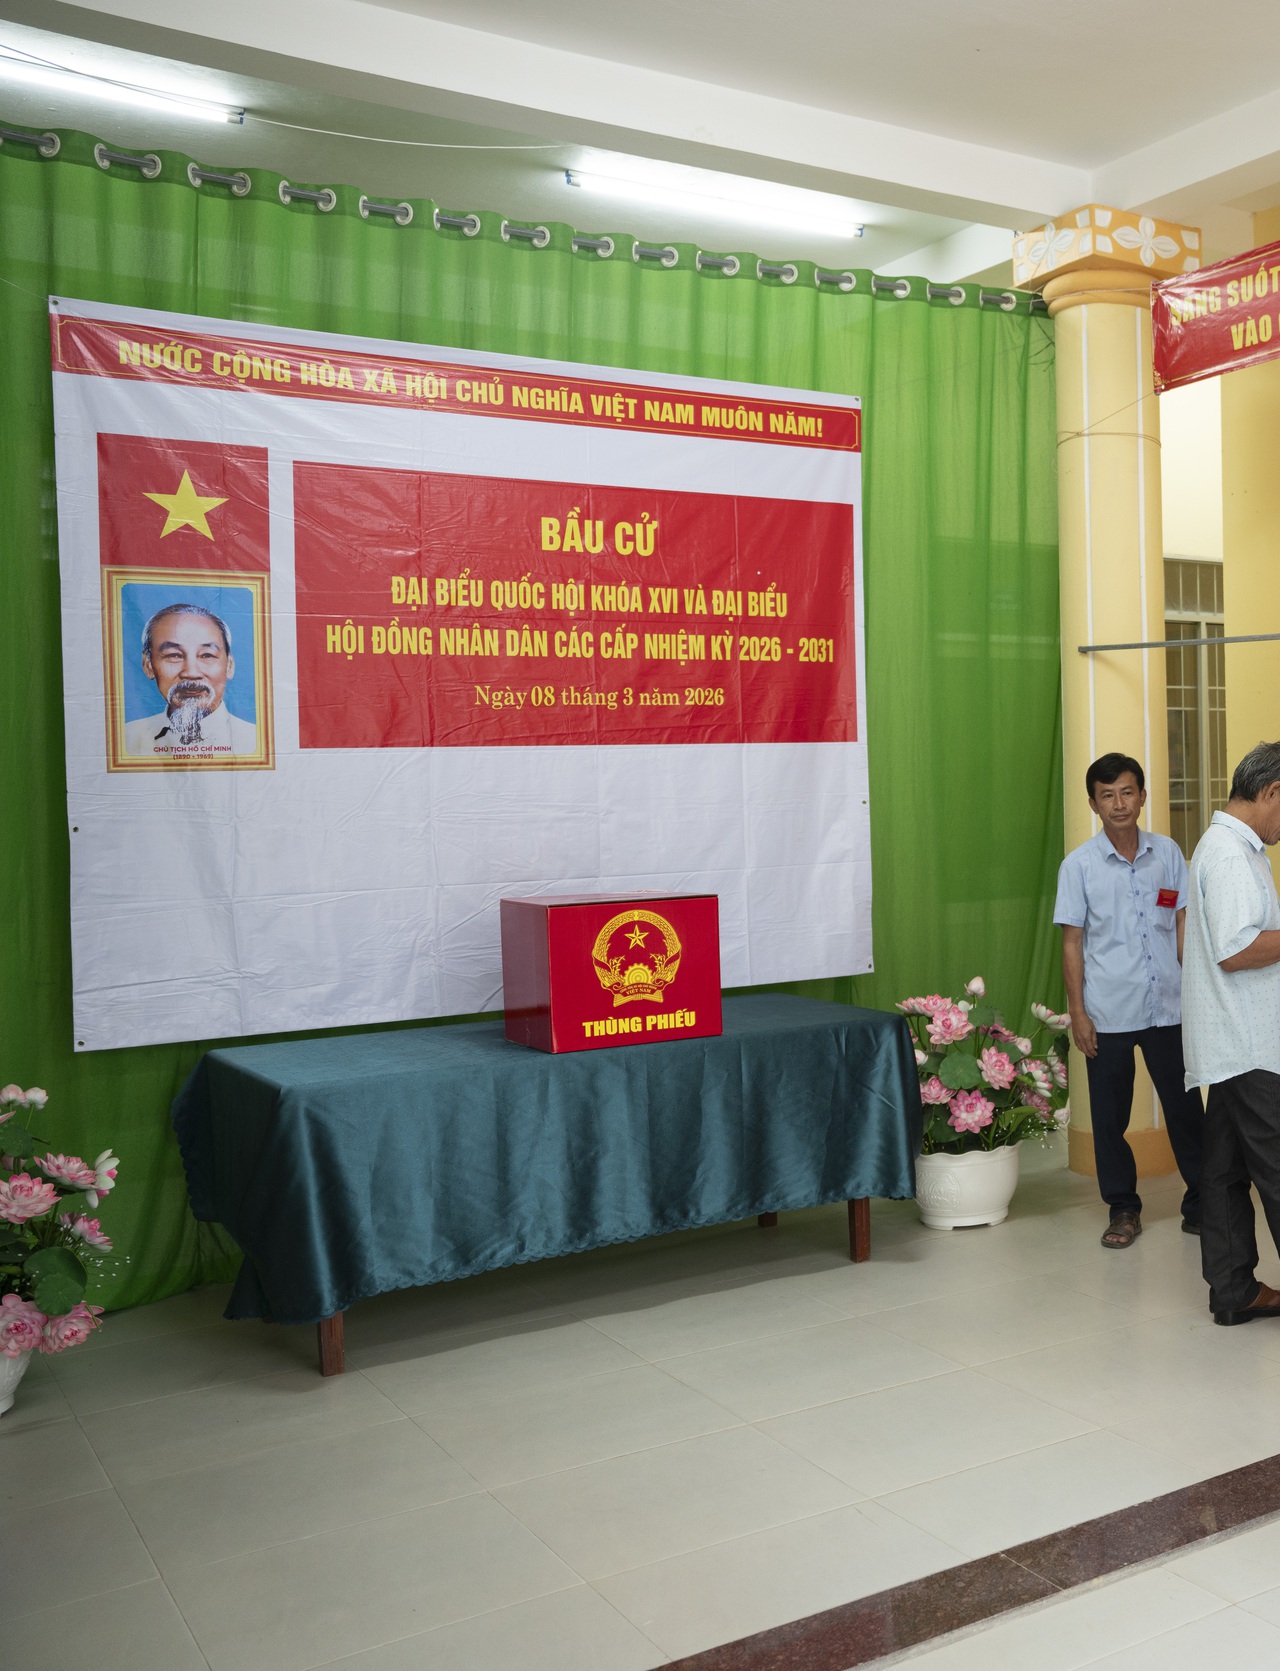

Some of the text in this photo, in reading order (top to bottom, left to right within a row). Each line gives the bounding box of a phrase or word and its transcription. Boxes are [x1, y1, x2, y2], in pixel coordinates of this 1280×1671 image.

[1226, 262, 1280, 307] SUỐT
[1230, 315, 1272, 351] VÀO
[119, 340, 823, 438] NƯỚC CỘNG HÒA XÃ HỘI CHỦ NGHĨA VIỆT NAM MUÔN NĂM!
[541, 506, 658, 556] BẦU CỬ
[391, 568, 788, 622] ĐẠI BIỂU QUỐC HỘI KHÓA XVI VÀ ĐẠI BIỂU
[326, 619, 365, 660] HỘI
[372, 617, 433, 655] ĐỒNG
[440, 622, 499, 656] NHÂN
[506, 624, 548, 657] DÂN
[554, 625, 594, 658] CÁC
[600, 623, 638, 659] CẤP
[644, 628, 705, 666] NHIỆM
[711, 630, 734, 661] KỲ
[739, 636, 781, 662] 2026
[798, 637, 834, 663] 2031
[474, 685, 725, 710] Ngày 08 tháng 3 năm 2026
[582, 1008, 697, 1038] THÙNG PHIẾU
